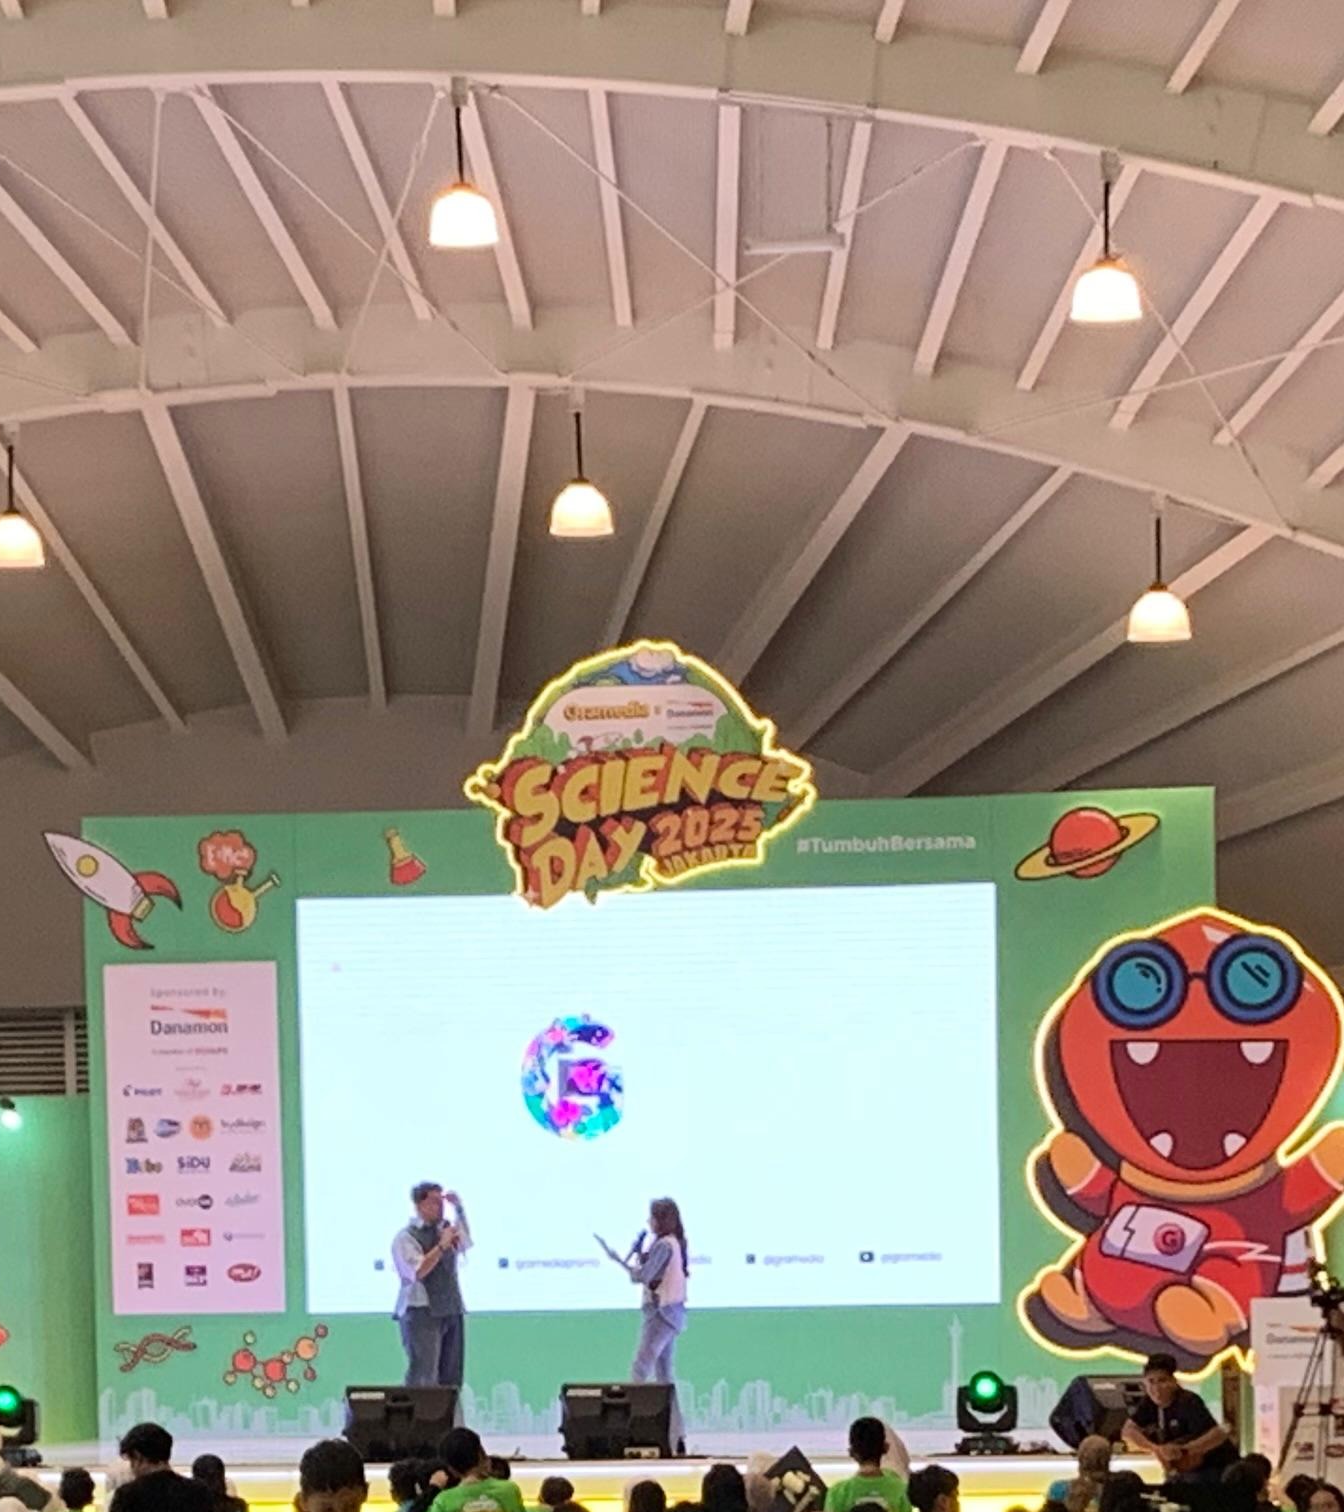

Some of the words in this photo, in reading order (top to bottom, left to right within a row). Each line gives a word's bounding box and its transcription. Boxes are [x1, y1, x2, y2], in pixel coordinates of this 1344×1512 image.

[511, 750, 796, 847] SCIENCE
[528, 818, 648, 908] DAY
[656, 804, 764, 854] 2025
[796, 833, 976, 855] #TumbuhBersama
[150, 1020, 229, 1036] Danamon
